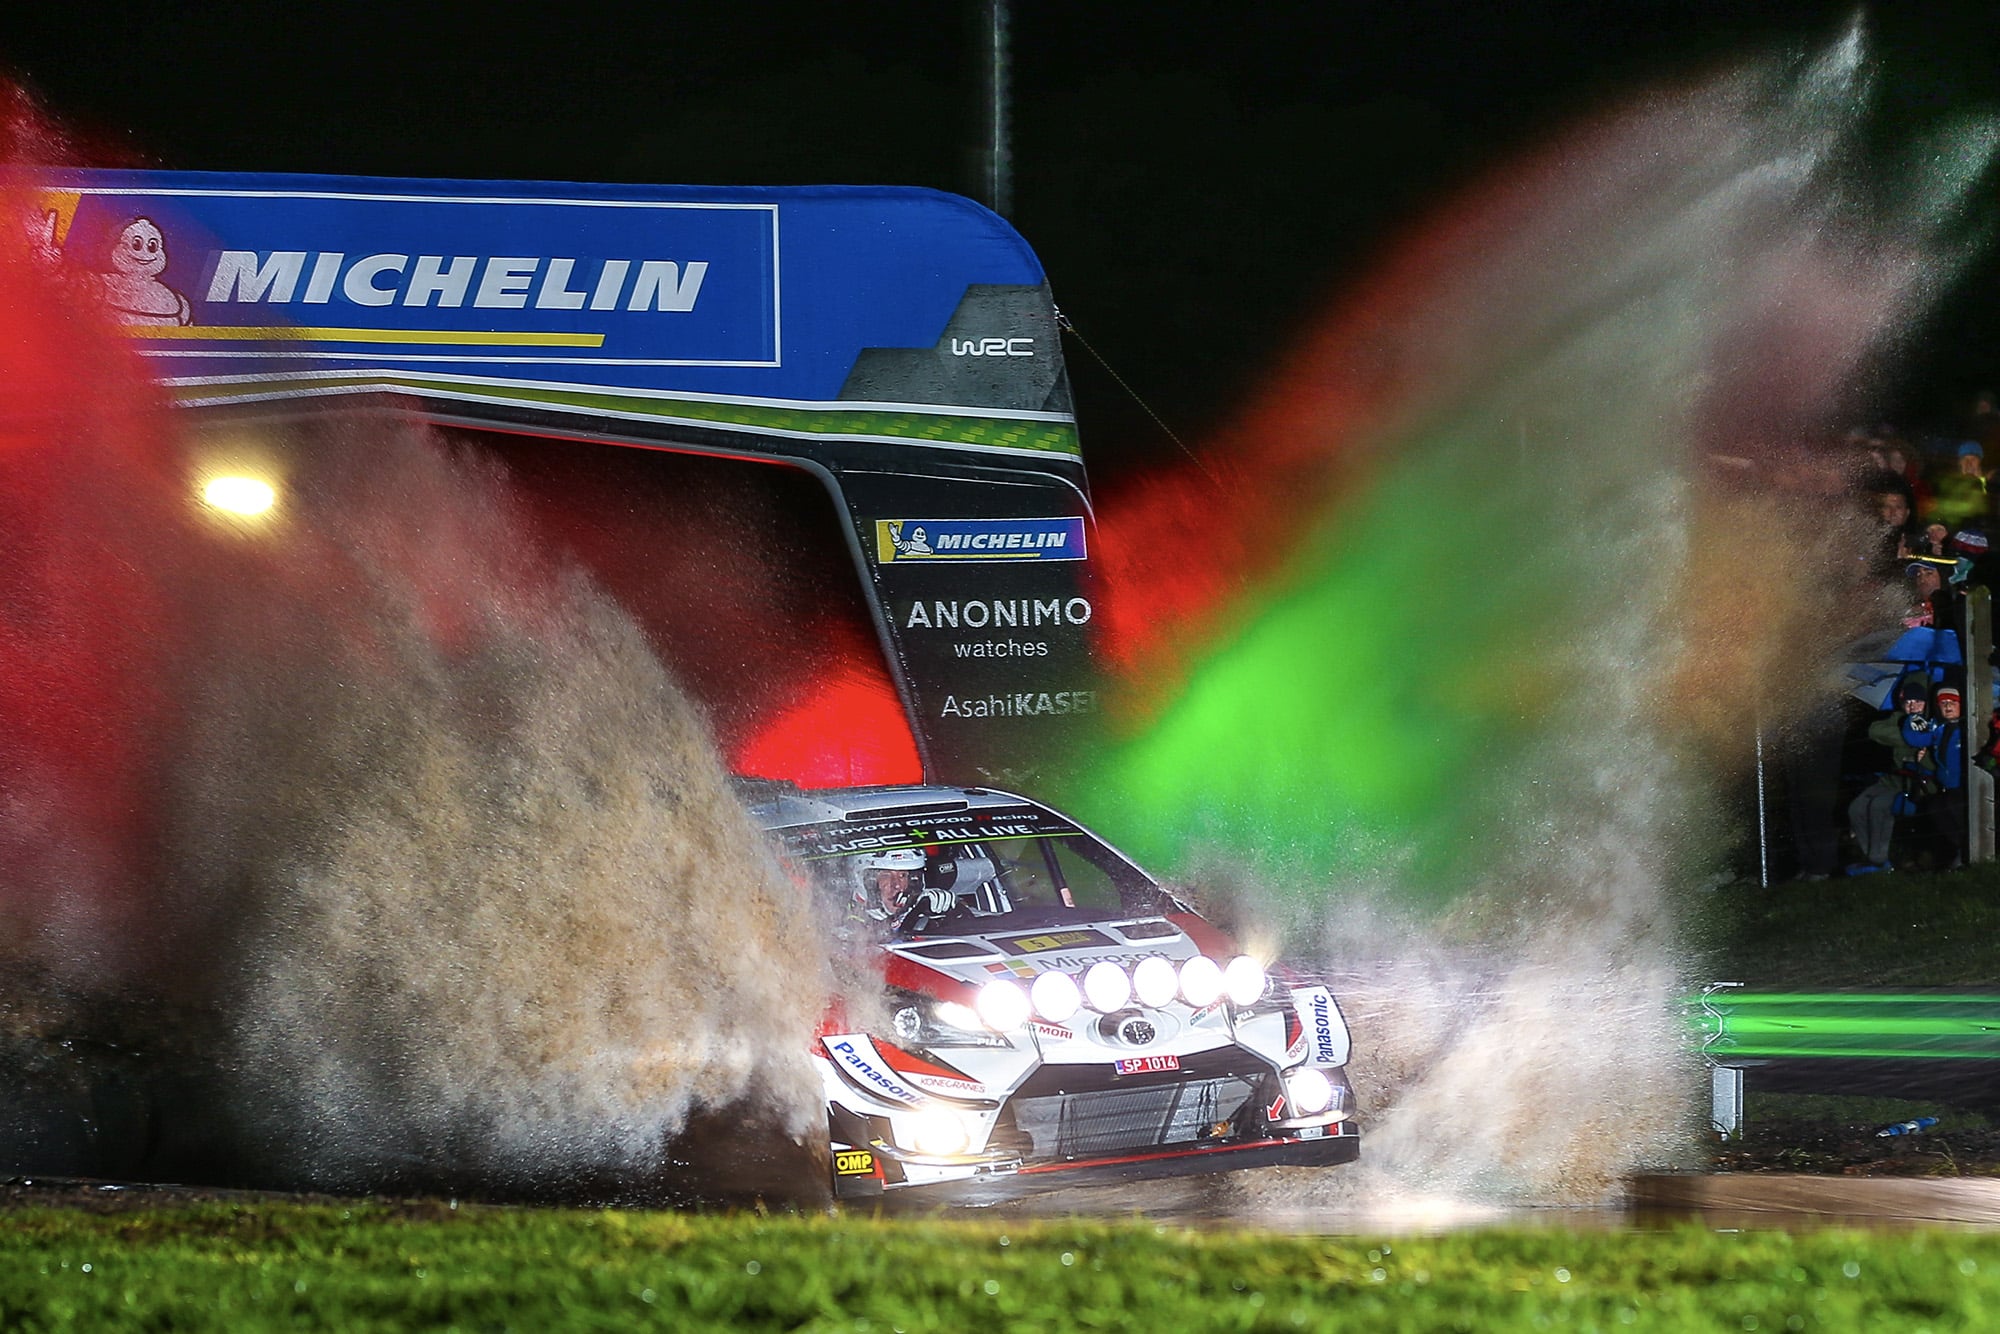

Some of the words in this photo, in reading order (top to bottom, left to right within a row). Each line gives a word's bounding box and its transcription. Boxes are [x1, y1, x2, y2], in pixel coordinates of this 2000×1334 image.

[206, 251, 708, 312] MICHELIN
[952, 338, 1034, 356] WRC
[937, 533, 1067, 549] MICHELIN
[906, 597, 1092, 628] ANONIMO
[954, 639, 1048, 658] watches
[829, 822, 902, 836] TOYOTA
[906, 815, 973, 826] GAZOO
[977, 813, 1038, 822] Racing
[936, 828, 976, 840] ALL
[980, 825, 1032, 837] LIVE
[1031, 939, 1046, 949] 5
[1037, 950, 1170, 970] Microsoft
[1039, 1026, 1073, 1039] MORI
[1308, 994, 1336, 1063] Panasonic
[976, 1036, 1006, 1047] PIAA
[1124, 1059, 1142, 1072] SP
[1146, 1055, 1177, 1070] 1014
[834, 1041, 926, 1106] Panasoni
[920, 1077, 985, 1093] KONECRANES
[837, 1155, 872, 1170] OMP
